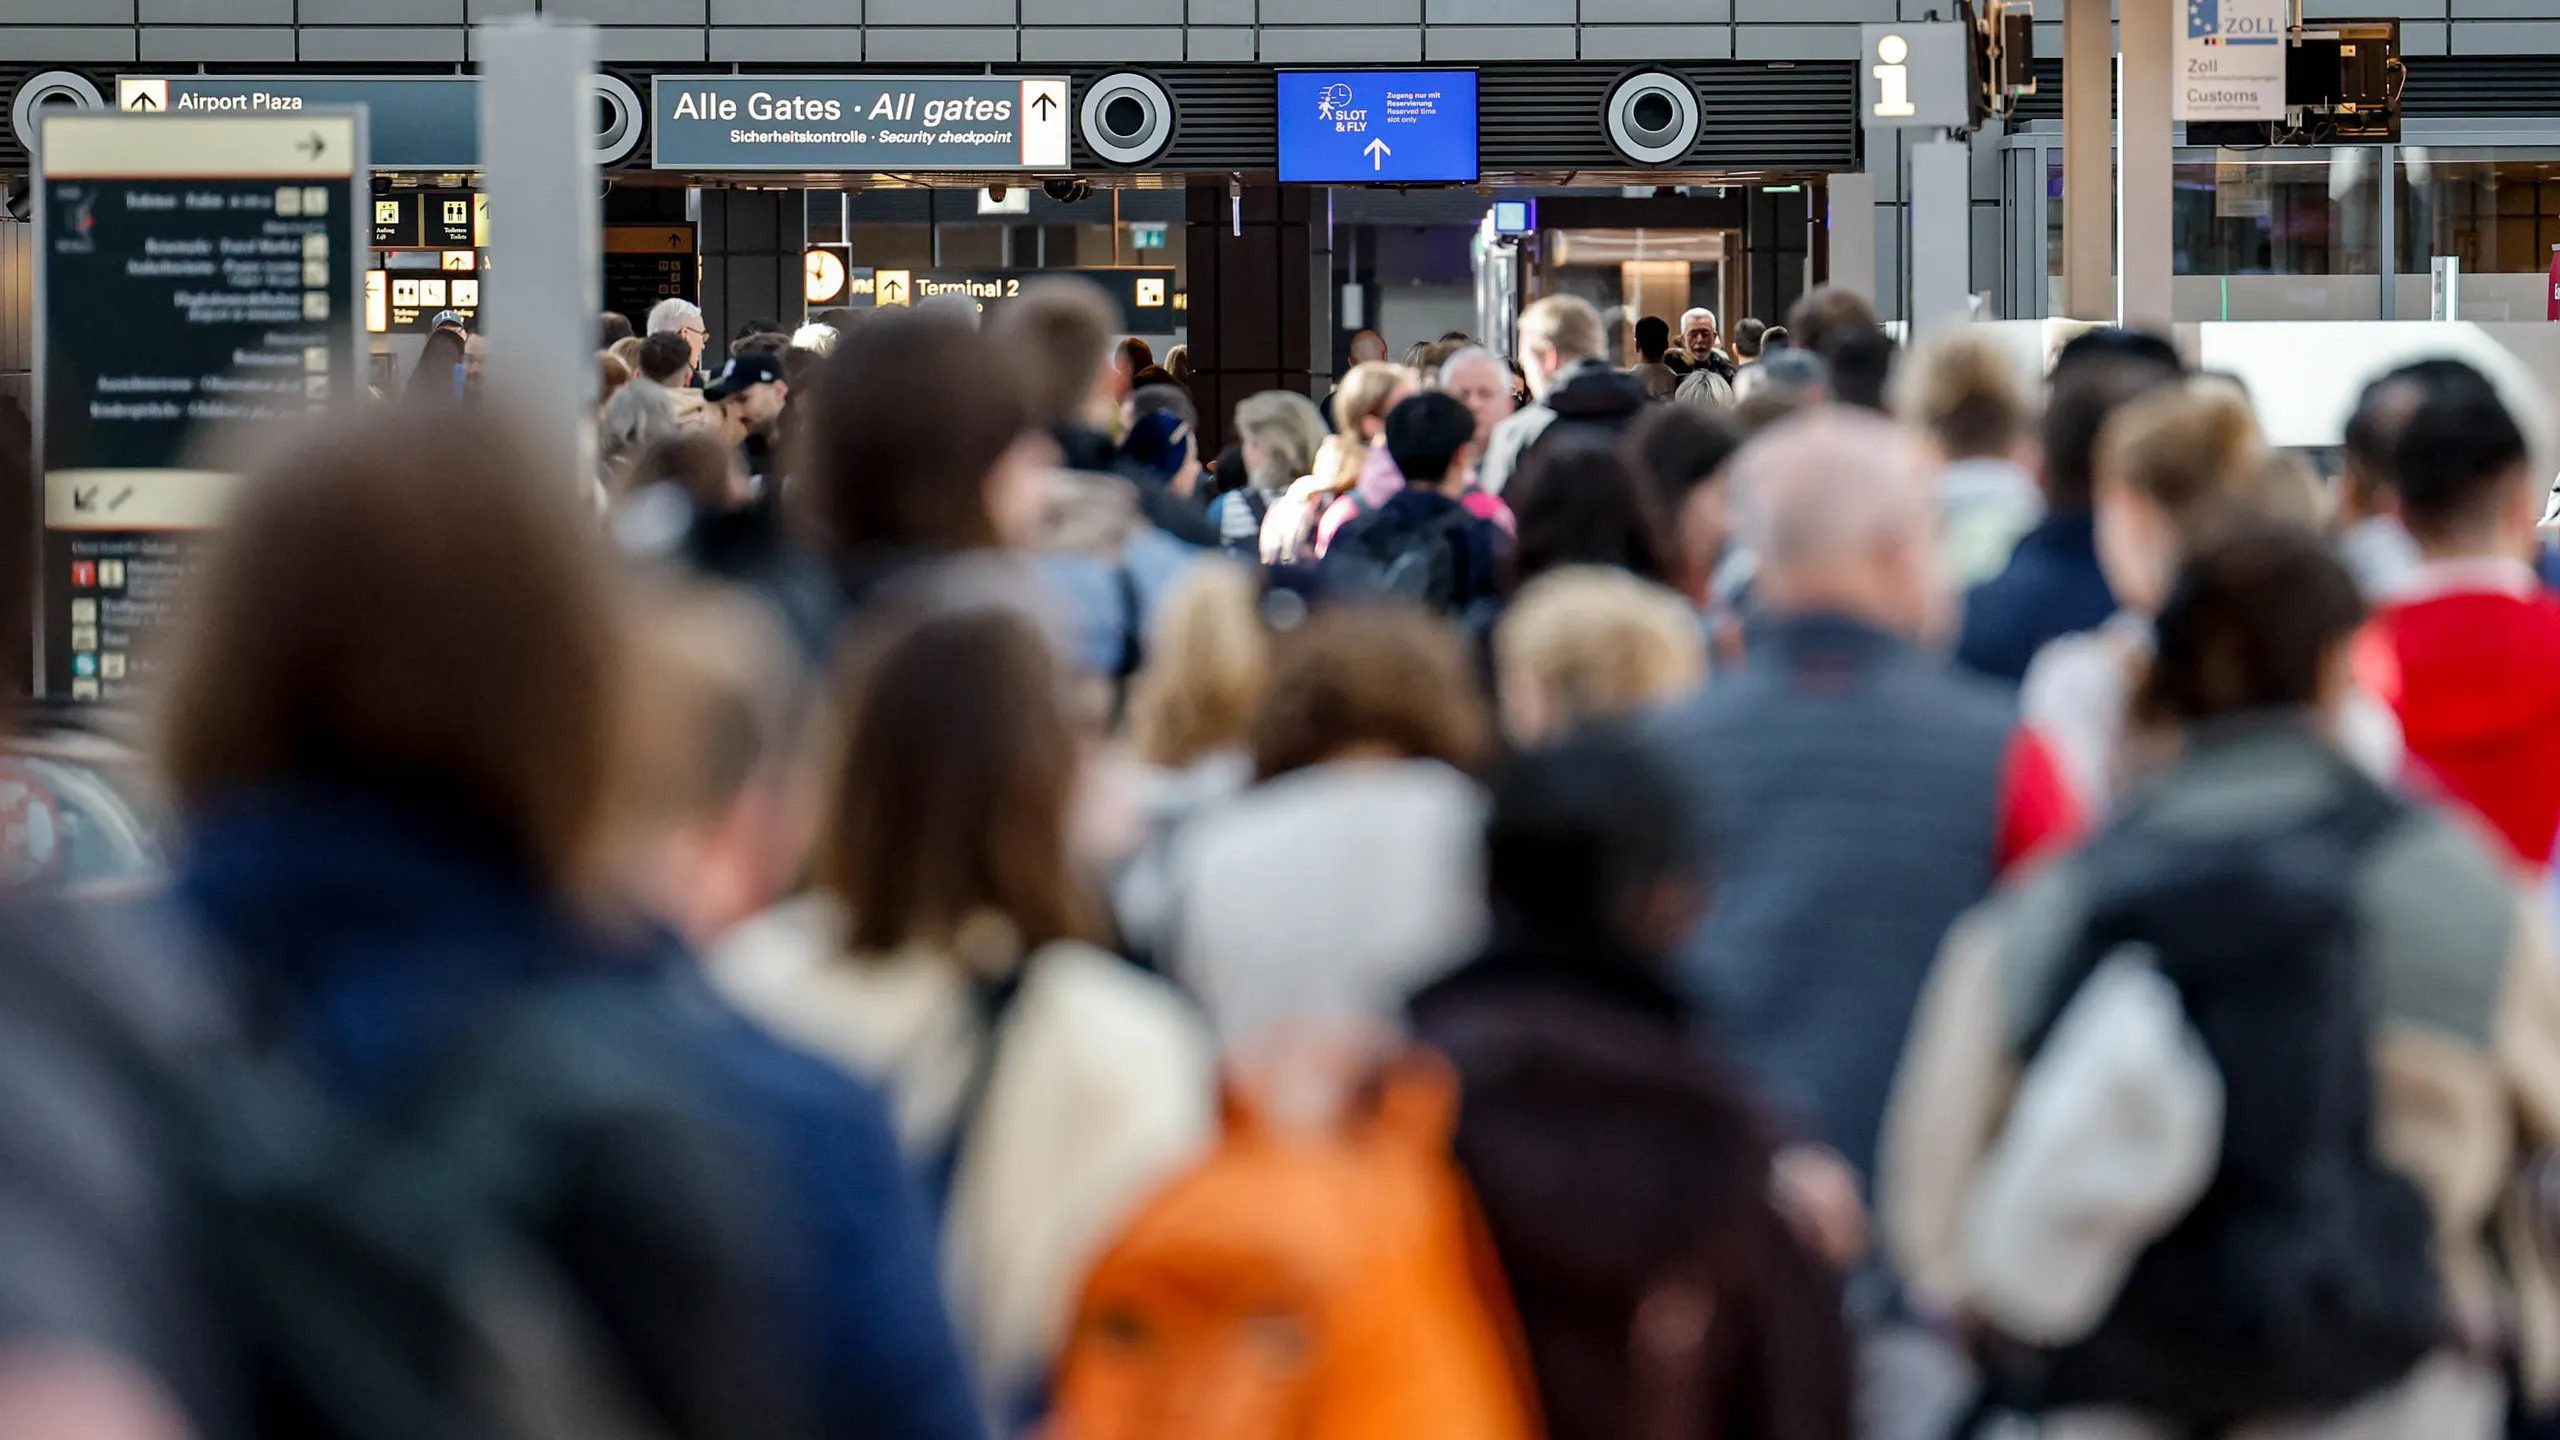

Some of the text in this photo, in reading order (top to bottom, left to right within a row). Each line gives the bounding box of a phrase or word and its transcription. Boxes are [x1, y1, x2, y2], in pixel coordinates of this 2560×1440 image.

[2225, 17, 2278, 34] ZOLL
[2188, 59, 2218, 73] Zoll
[178, 92, 303, 112] Airport Plaza
[1386, 92, 1414, 100] Zugang
[2187, 88, 2258, 103] Customs
[672, 92, 1013, 127] Alle Gates All gates
[1386, 100, 1433, 108] Reservierung
[1335, 110, 1368, 121] SLOT
[1401, 116, 1417, 124] only
[1335, 122, 1368, 132] & FLY
[730, 130, 1013, 146] Sicherheitskontrolle Security checkpoint
[915, 279, 1020, 297] Terminal 2
